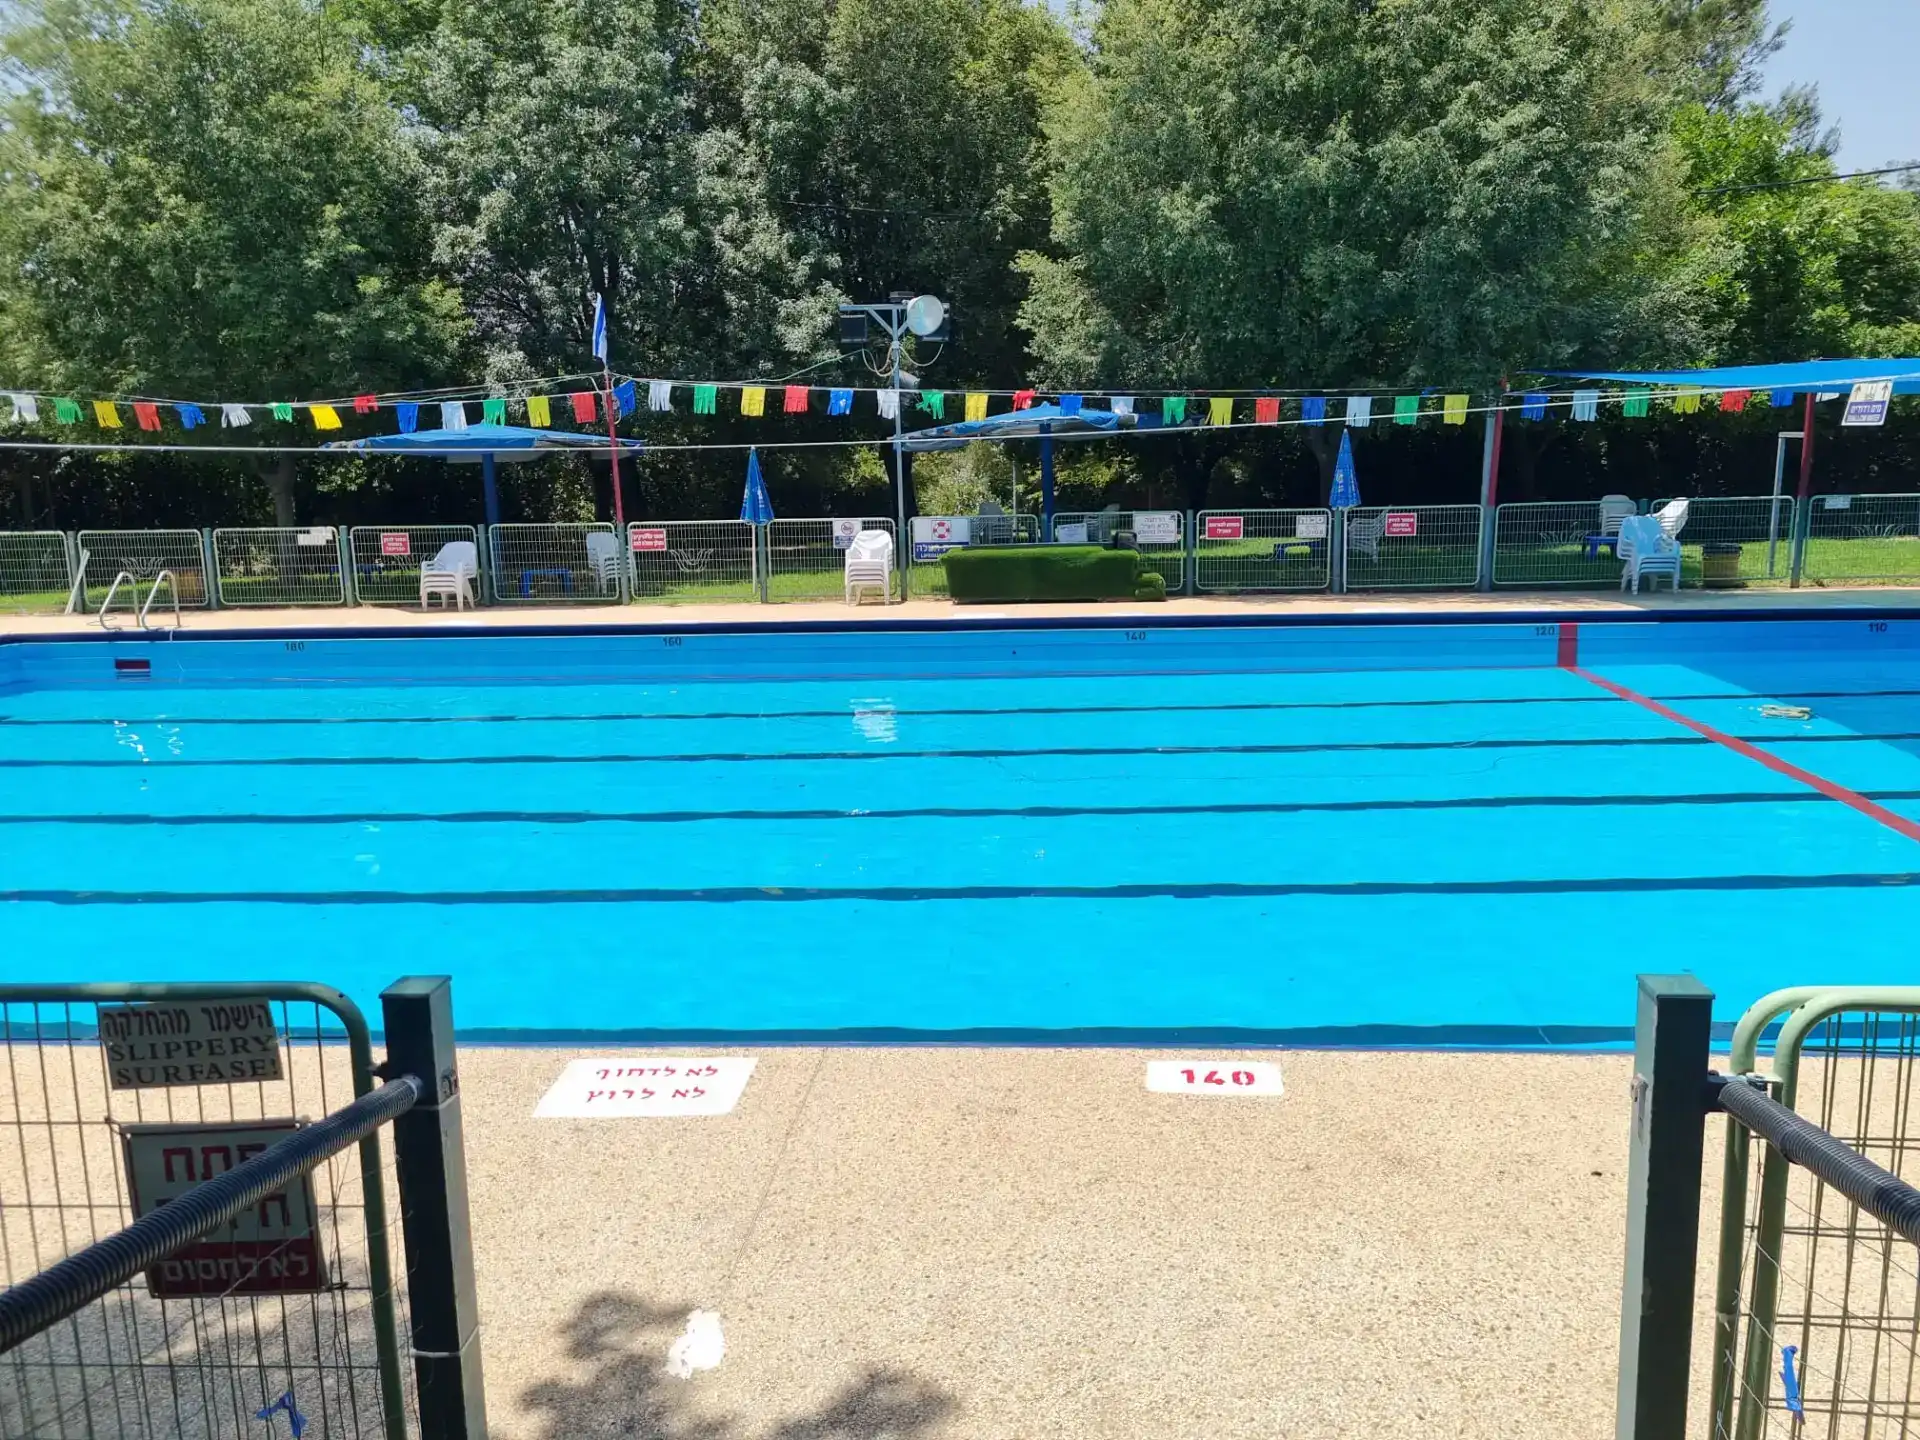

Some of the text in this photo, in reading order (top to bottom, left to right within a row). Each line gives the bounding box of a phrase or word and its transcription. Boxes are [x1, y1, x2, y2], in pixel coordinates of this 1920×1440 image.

[1535, 626, 1555, 636] 120
[1868, 622, 1888, 632] 110
[662, 636, 682, 647] 160
[1124, 631, 1146, 641] 140
[285, 641, 304, 652] 180
[102, 1004, 274, 1042] הישמר מהחלקה
[110, 1035, 276, 1062] SLIPPERY
[117, 1059, 279, 1086] SURFASE!
[596, 1065, 719, 1080] לא לדחוף
[1180, 1069, 1255, 1086] 140
[586, 1086, 706, 1103] לא לרוץ
[163, 1251, 310, 1282] לא לחסום
